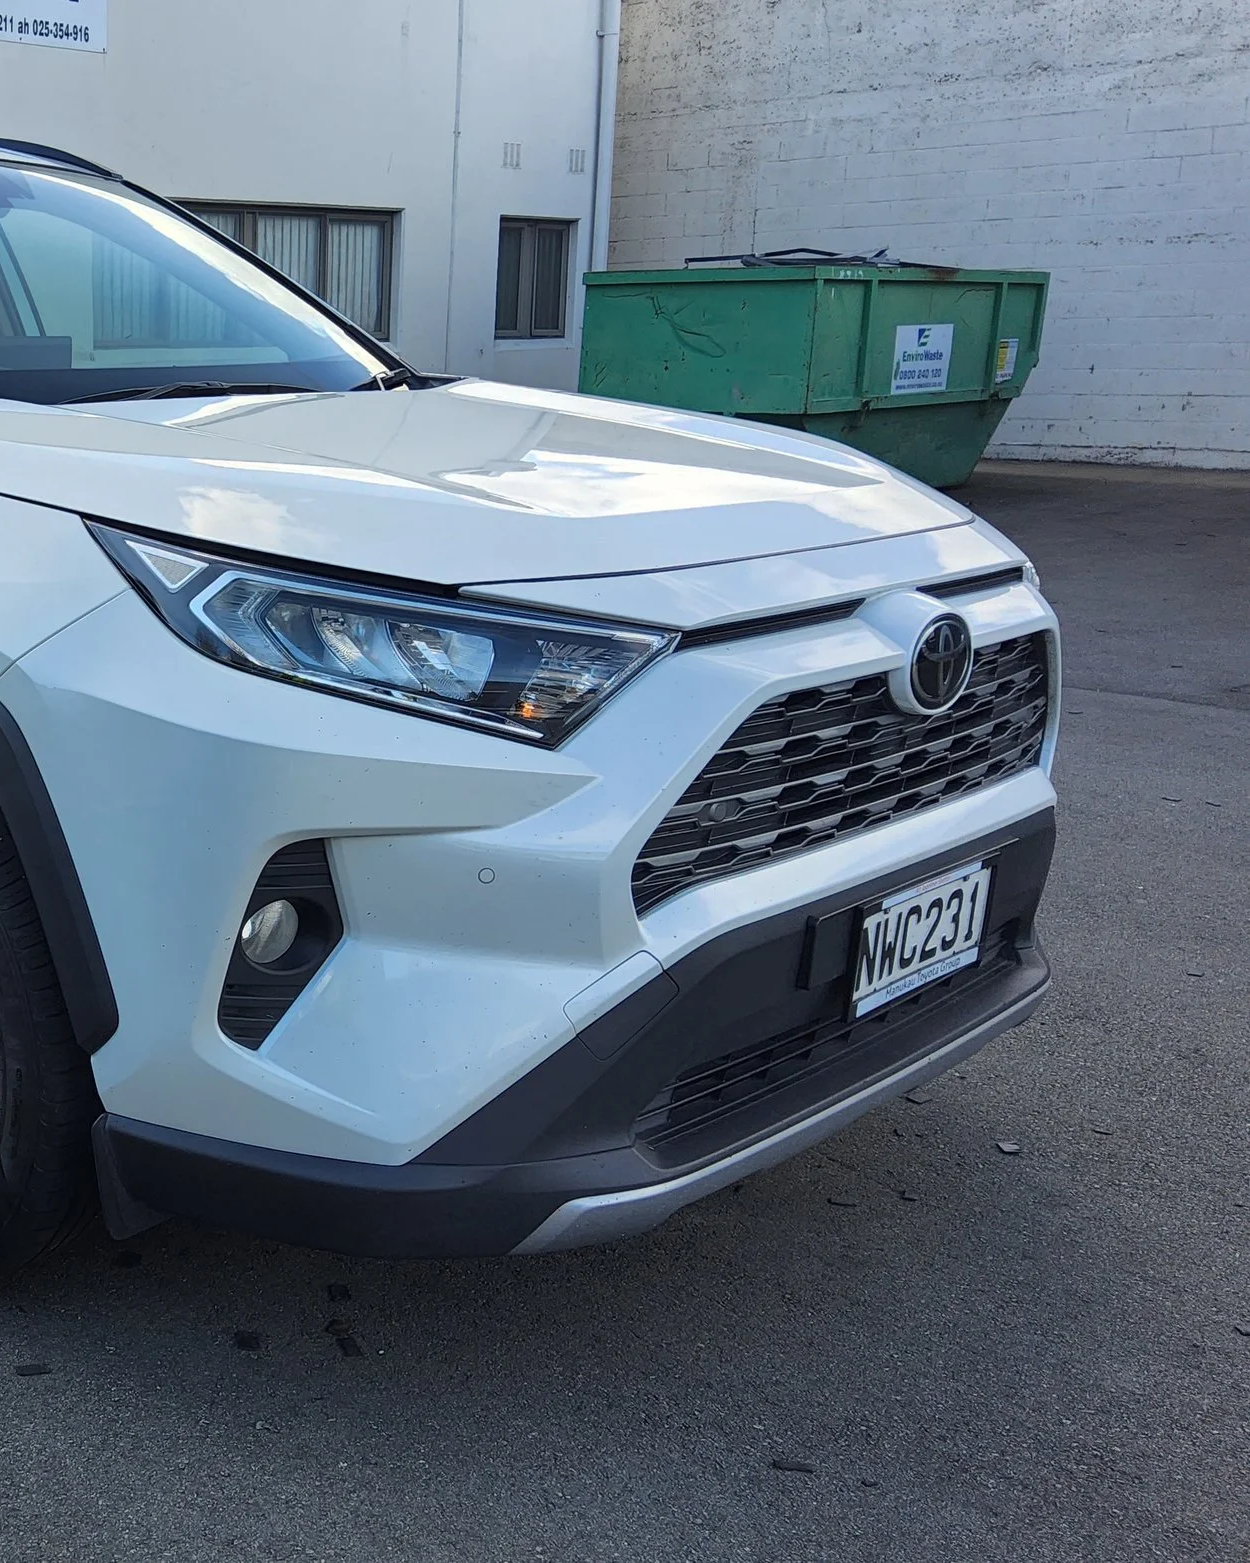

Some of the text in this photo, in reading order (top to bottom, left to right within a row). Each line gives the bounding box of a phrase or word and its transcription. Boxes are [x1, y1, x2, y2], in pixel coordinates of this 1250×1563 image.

[18, 17, 29, 34] ah
[33, 19, 90, 42] 025-354-916
[899, 369, 917, 380] 0800
[931, 368, 942, 378] 120
[855, 880, 980, 993] NWC231
[885, 957, 961, 999] Manukau Toyota Group
